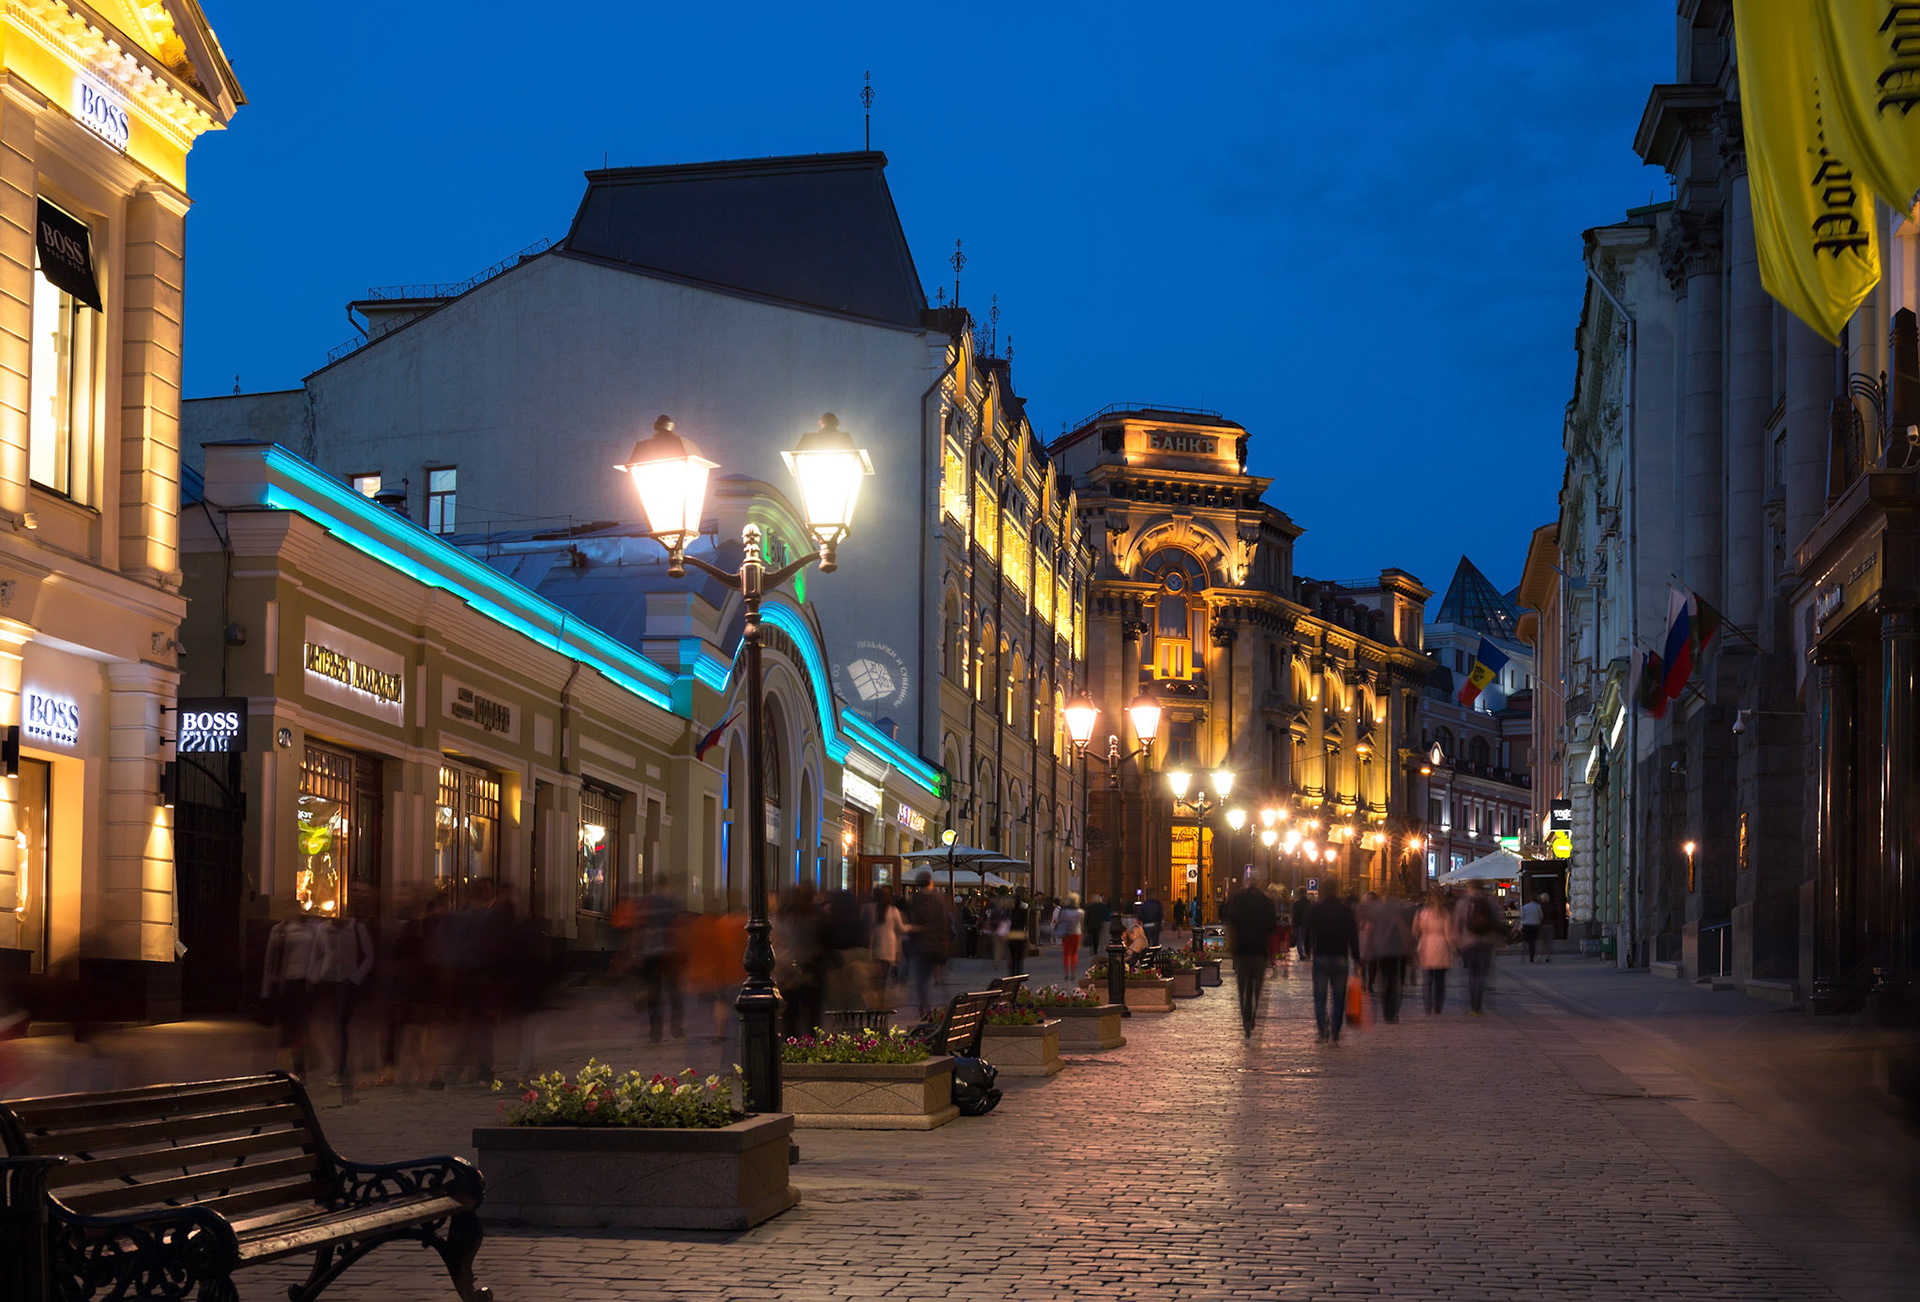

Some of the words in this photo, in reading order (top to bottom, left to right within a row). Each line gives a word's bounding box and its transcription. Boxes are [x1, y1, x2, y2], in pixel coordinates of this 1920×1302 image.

[81, 82, 129, 141] BOSS
[41, 221, 85, 265] BOSS
[1150, 434, 1216, 454] БАНКЪ
[857, 641, 897, 659] ПОДАРКИ
[893, 666, 909, 708] СУВЕНИРЫ
[29, 694, 79, 732] BOSS
[182, 712, 239, 731] BOSS
[1309, 879, 1317, 890] P
